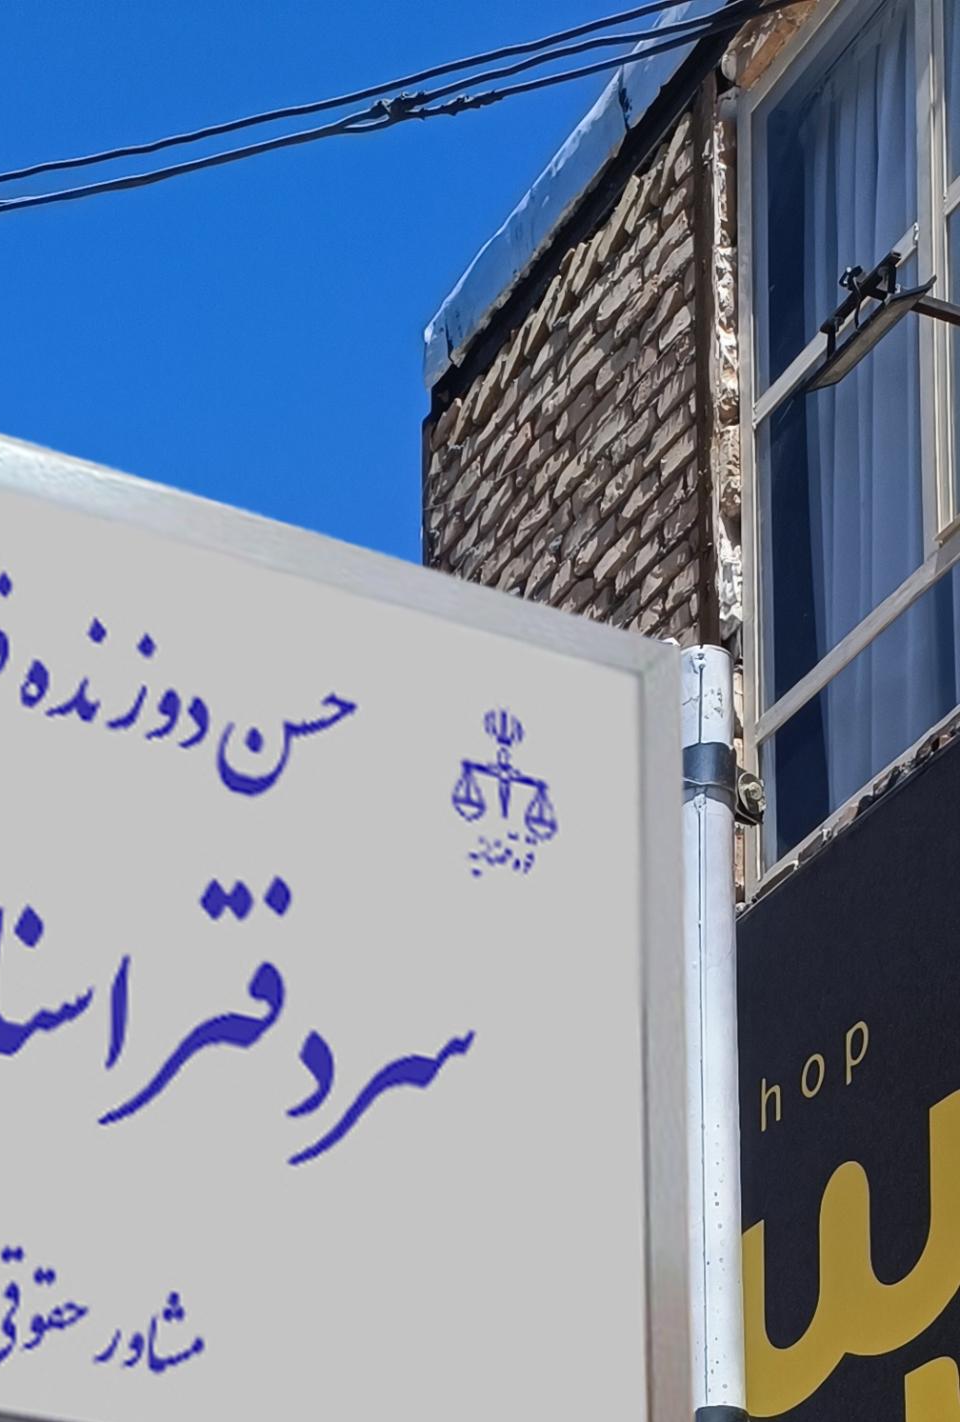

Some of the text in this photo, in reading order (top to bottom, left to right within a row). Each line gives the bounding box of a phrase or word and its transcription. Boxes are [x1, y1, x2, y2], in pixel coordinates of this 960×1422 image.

[216, 693, 358, 797] حسن
[759, 1020, 870, 1133] hop
[90, 1290, 206, 1375] مشاور
